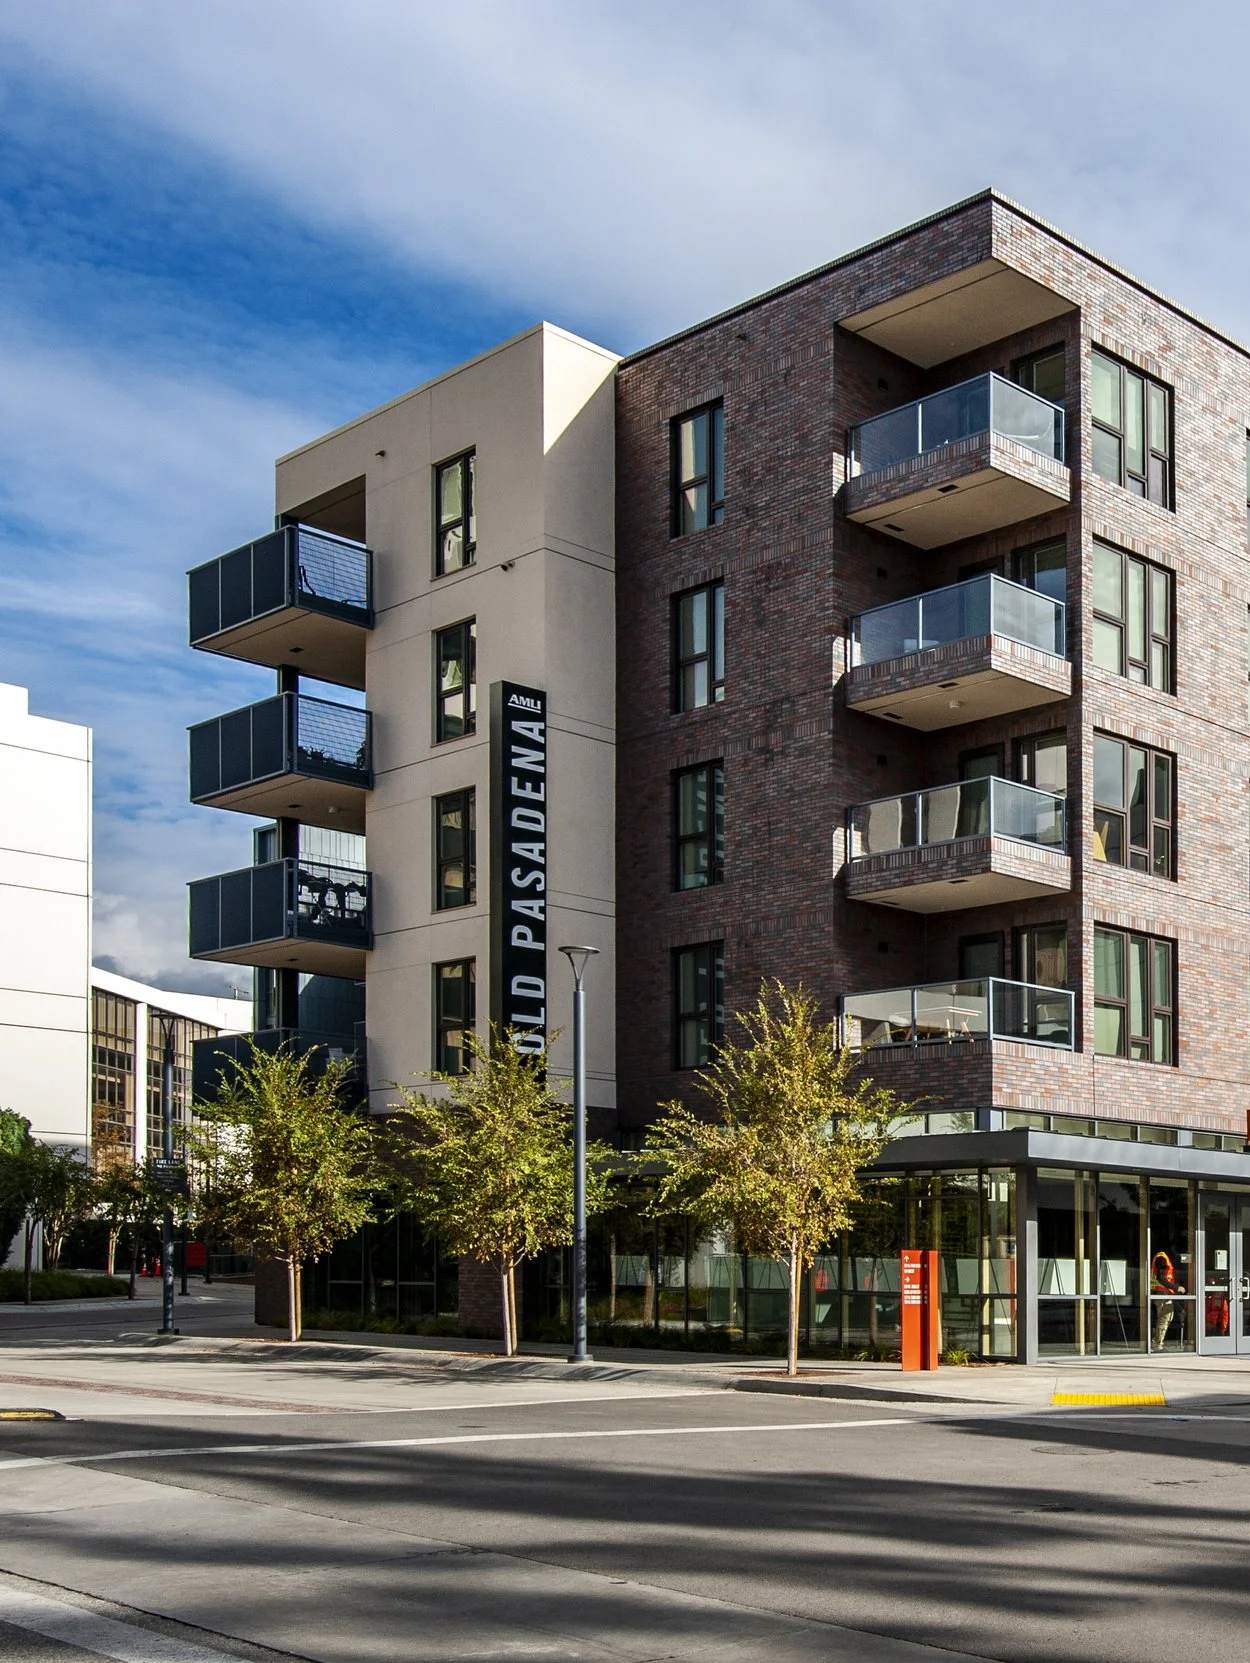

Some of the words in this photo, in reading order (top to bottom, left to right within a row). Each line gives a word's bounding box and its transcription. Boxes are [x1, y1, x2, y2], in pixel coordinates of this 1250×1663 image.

[508, 693, 542, 713] AMLI
[511, 720, 545, 951] PASADENA
[511, 974, 545, 1056] OLD
